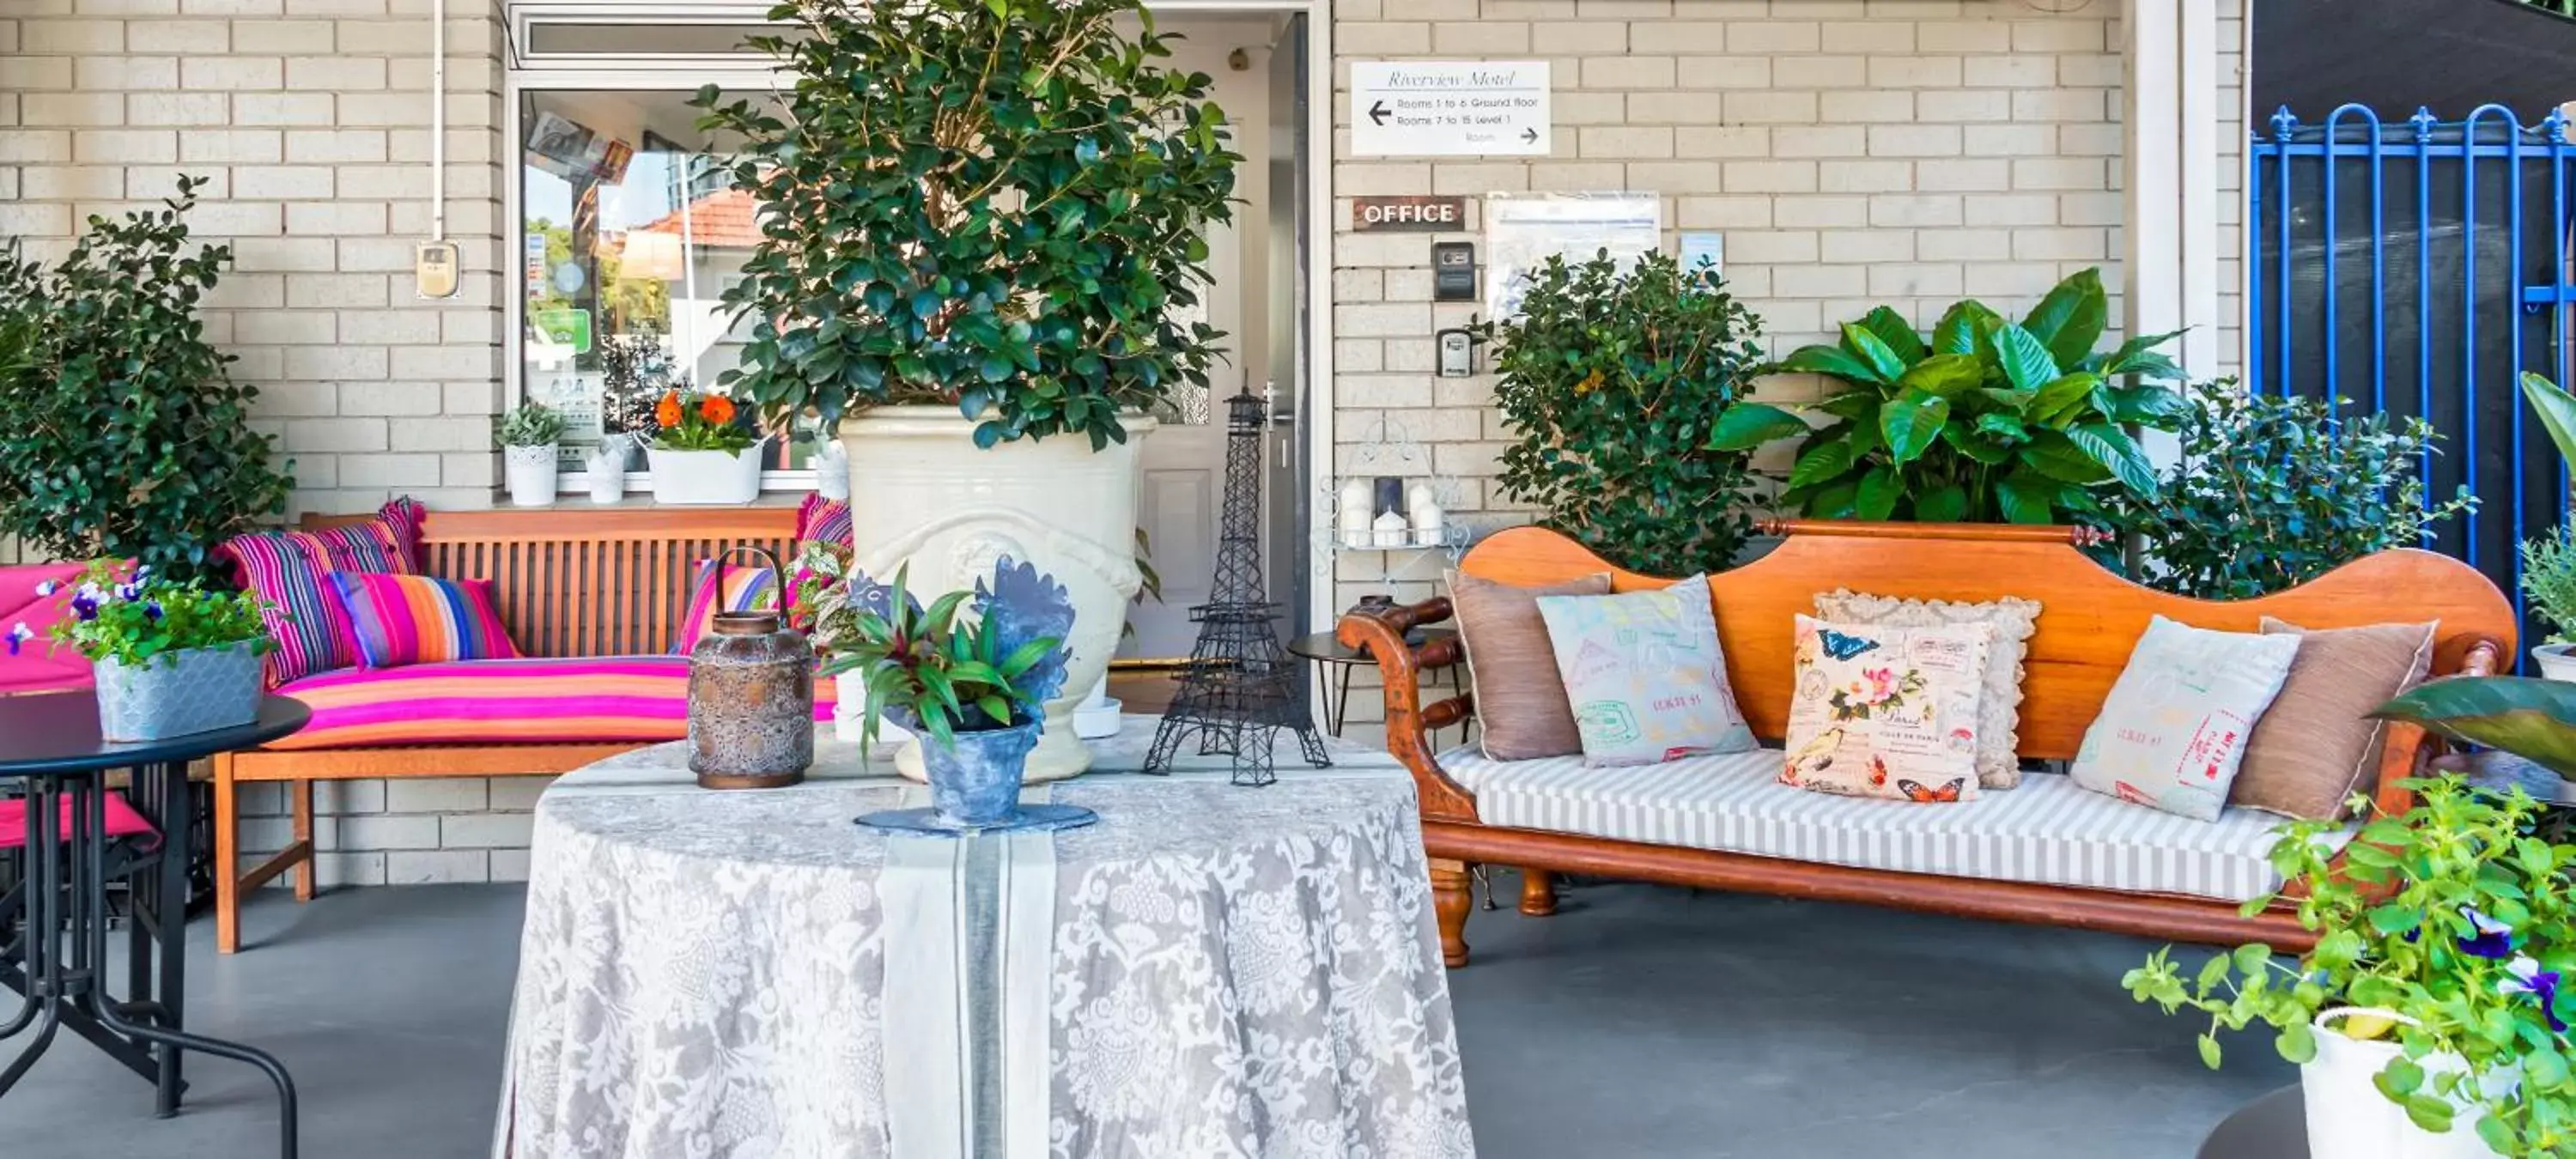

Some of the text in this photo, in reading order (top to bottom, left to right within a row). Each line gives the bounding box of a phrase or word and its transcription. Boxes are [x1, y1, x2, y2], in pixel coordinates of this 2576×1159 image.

[1388, 70, 1516, 87] Riverview Motel
[1397, 98, 1432, 109] Rooms
[1436, 98, 1441, 108] 1
[1445, 99, 1455, 108] to
[1460, 99, 1467, 108] 6
[1471, 98, 1510, 108] Ground
[1397, 116, 1432, 126] Rooms
[1437, 116, 1442, 124] 7
[1446, 115, 1457, 124] to
[1475, 114, 1502, 124] Level
[1505, 114, 1510, 124] 1
[1364, 204, 1455, 222] OFFICE
